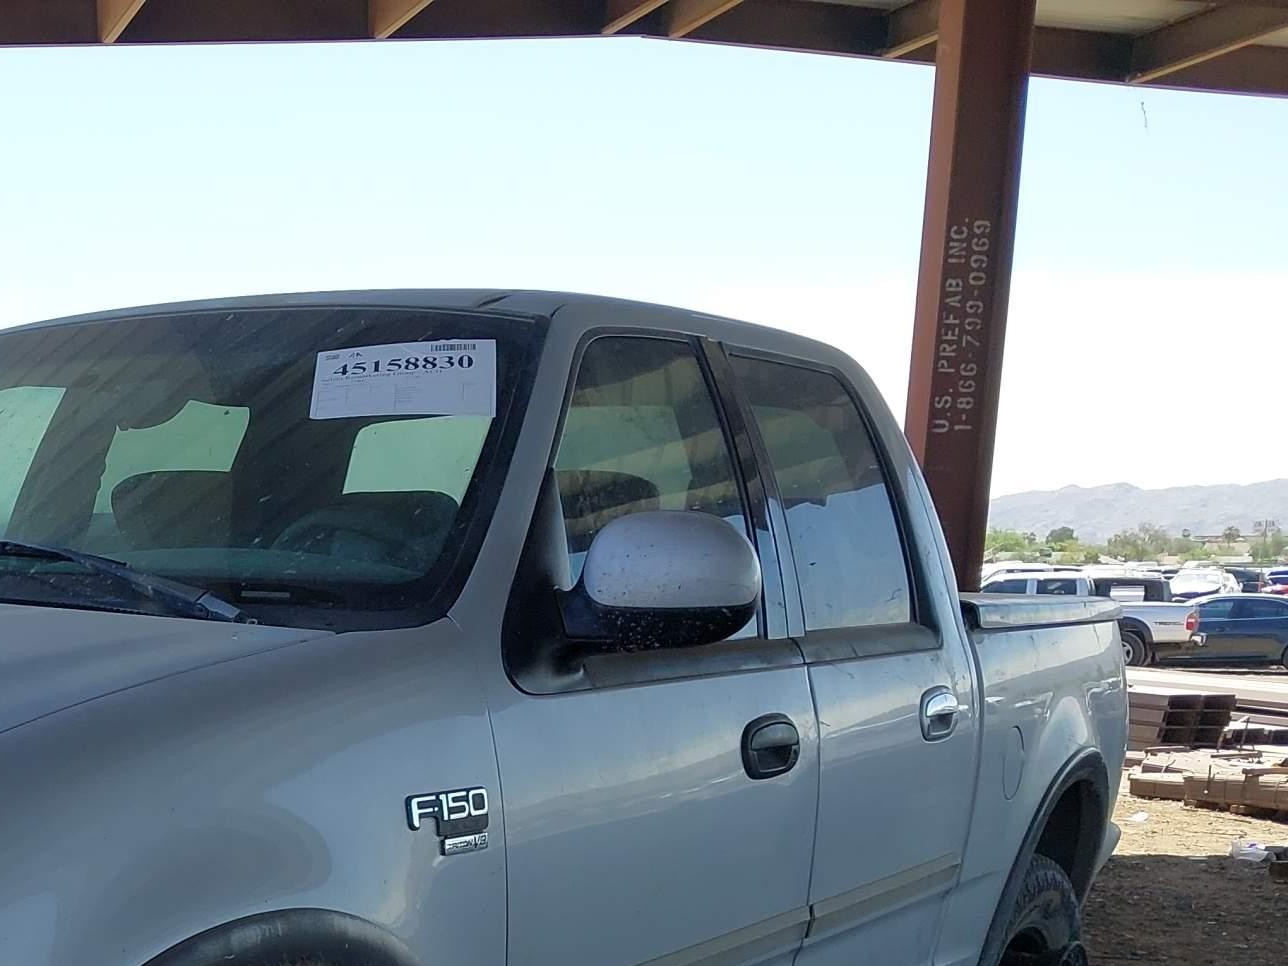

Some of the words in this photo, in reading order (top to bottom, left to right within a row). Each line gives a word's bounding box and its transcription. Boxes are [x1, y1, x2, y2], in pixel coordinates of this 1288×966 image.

[948, 217, 969, 263] INC.
[938, 278, 963, 373] PREFAB
[954, 220, 991, 431] 1-866-799-0969
[333, 354, 474, 376] 45158830
[932, 388, 953, 433] U.S.
